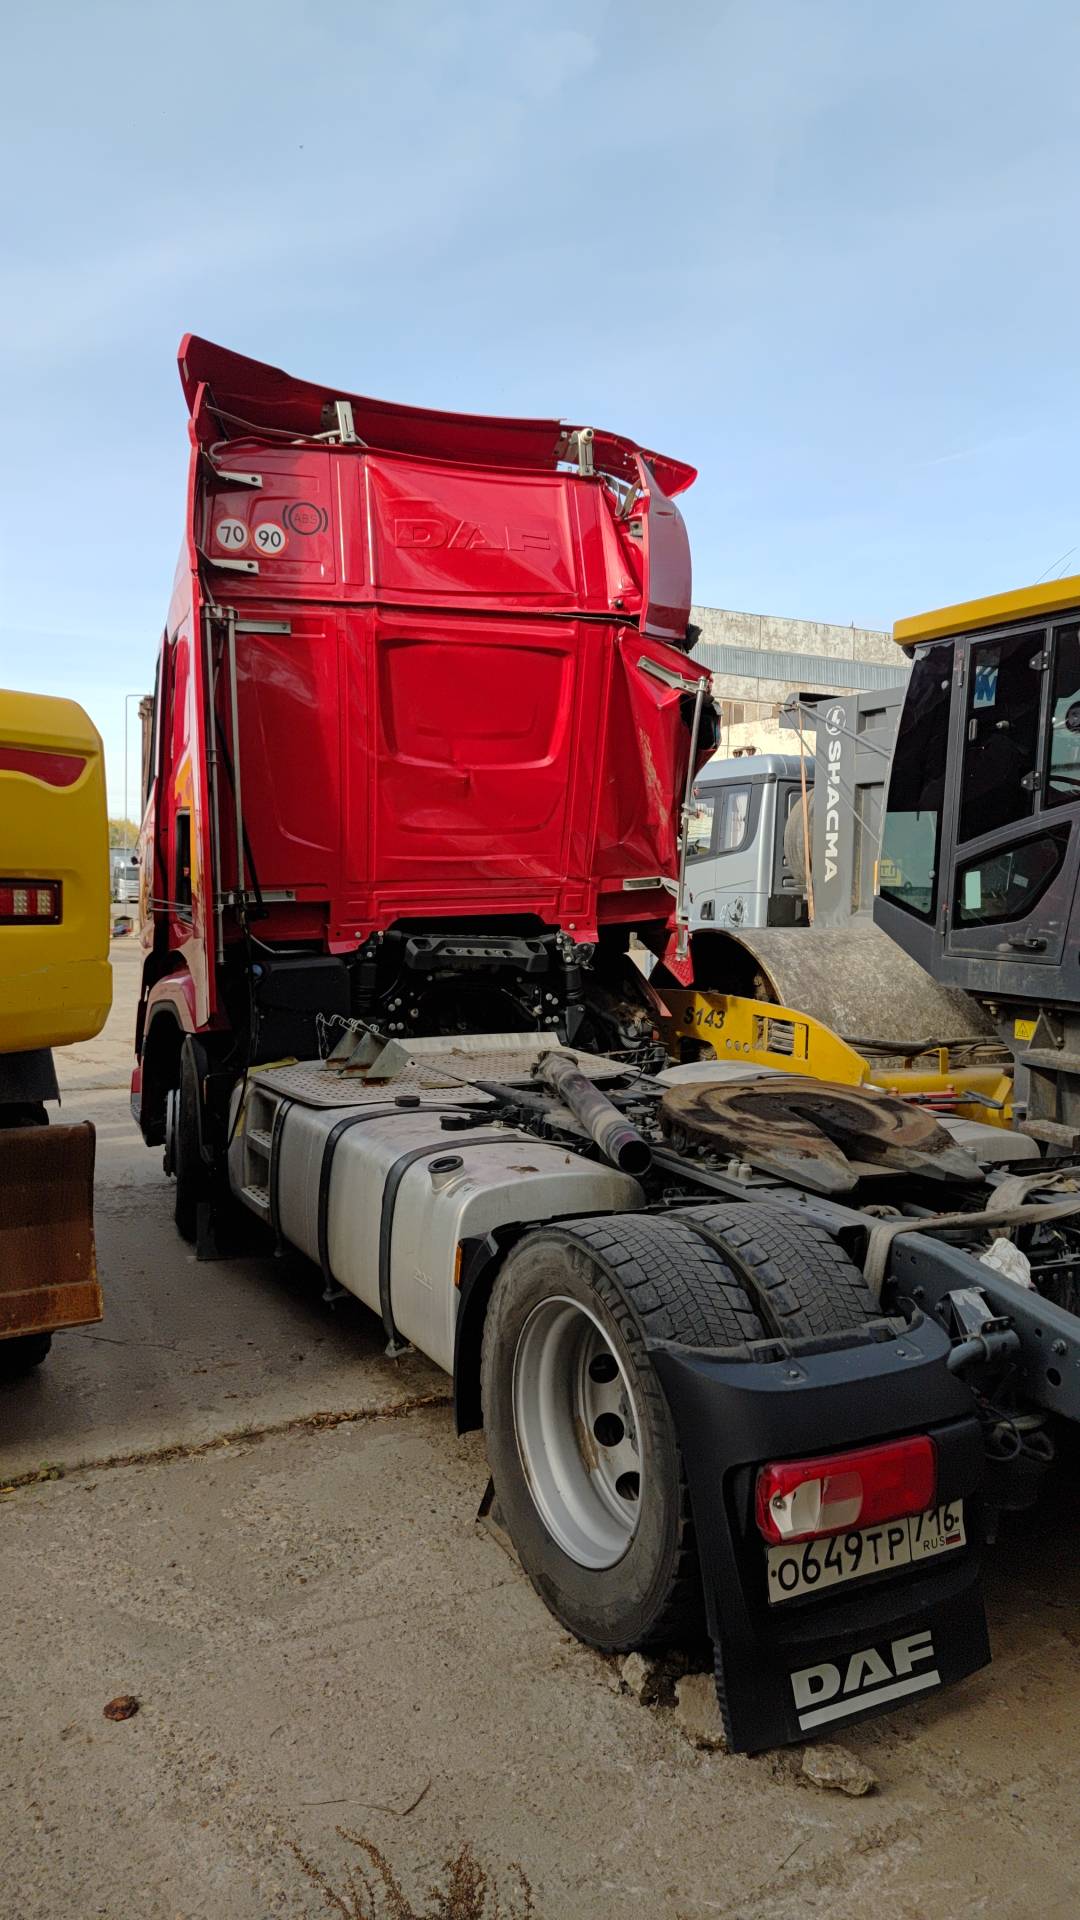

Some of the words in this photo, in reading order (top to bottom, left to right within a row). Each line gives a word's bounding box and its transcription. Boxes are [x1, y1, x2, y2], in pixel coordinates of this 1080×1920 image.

[220, 525, 245, 543] 70
[258, 530, 282, 548] 90
[395, 518, 551, 552] DAF
[824, 740, 843, 882] SHACMA
[923, 1535, 946, 1552] RUS
[791, 1630, 935, 1710] DAF
